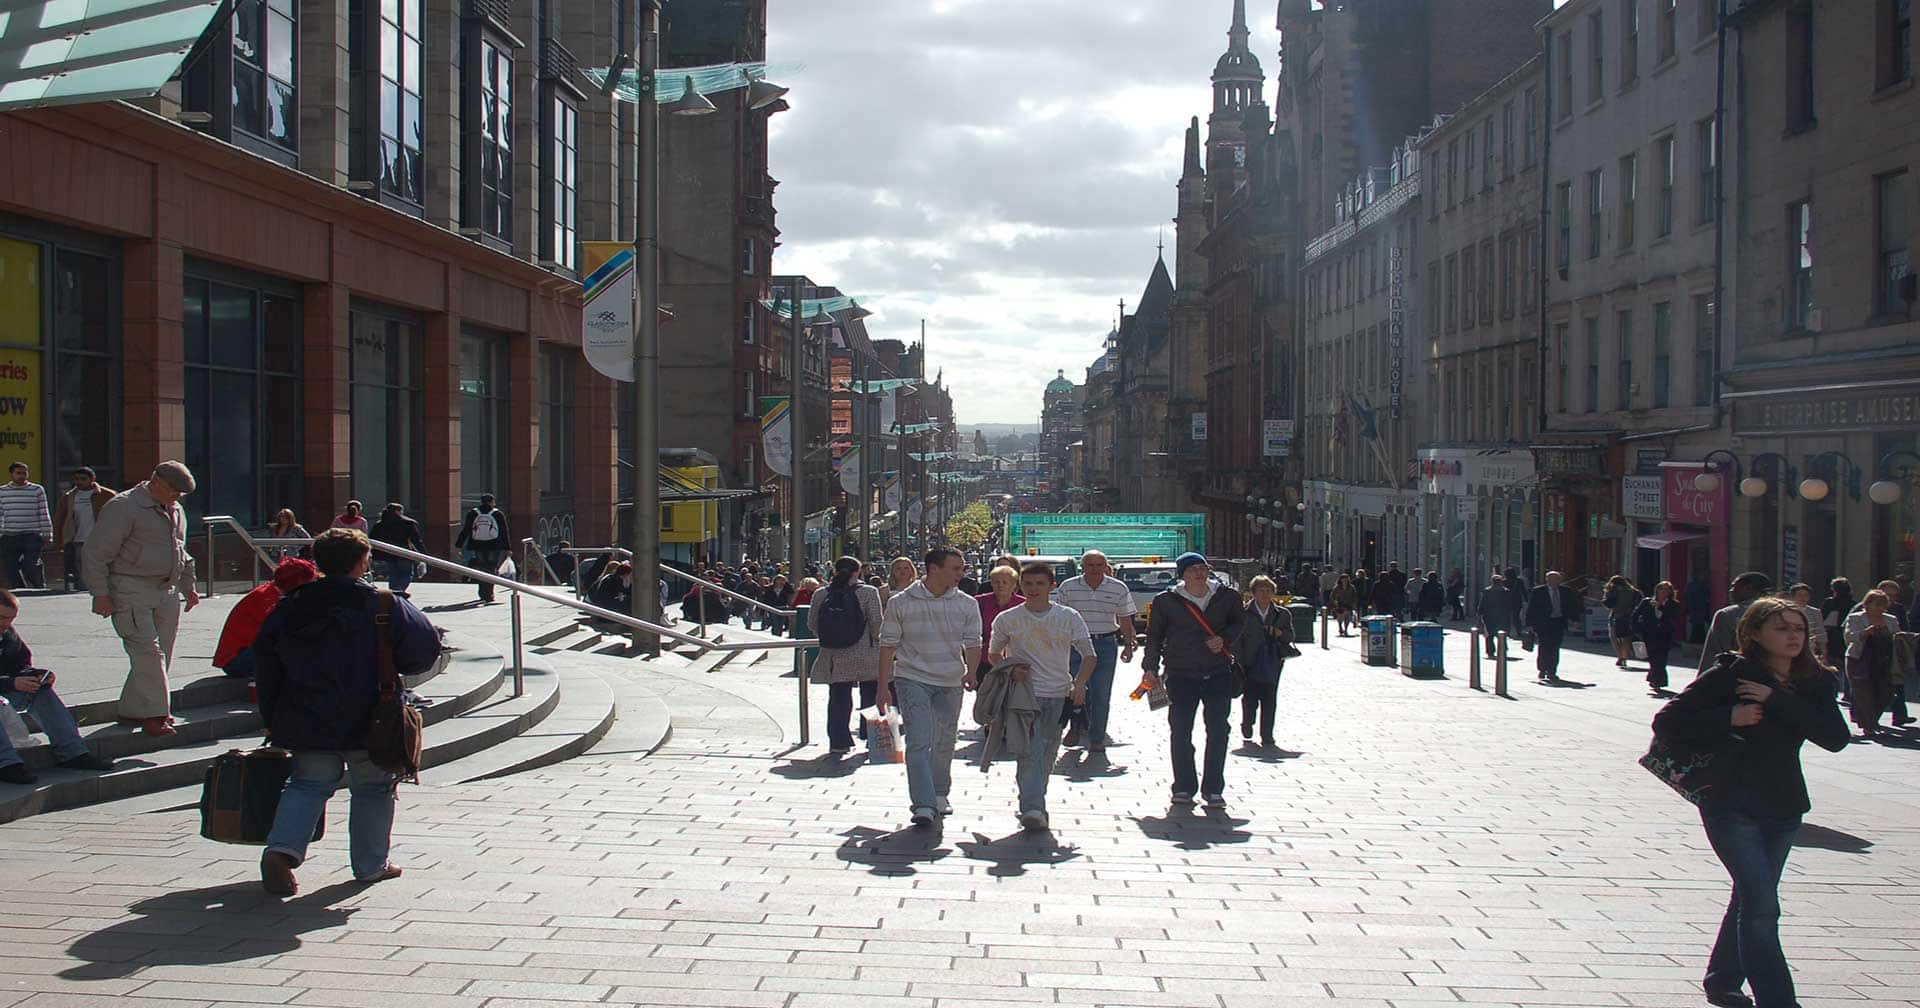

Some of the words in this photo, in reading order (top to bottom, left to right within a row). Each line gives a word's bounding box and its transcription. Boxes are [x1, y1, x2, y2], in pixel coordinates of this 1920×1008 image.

[1391, 247, 1402, 347] BUCHANAN
[1391, 358, 1401, 418] HOTEL
[1763, 401, 1848, 427] ENTERPRISE
[1634, 490, 1660, 503] STREET
[1043, 515, 1116, 524] BUCHANAN
